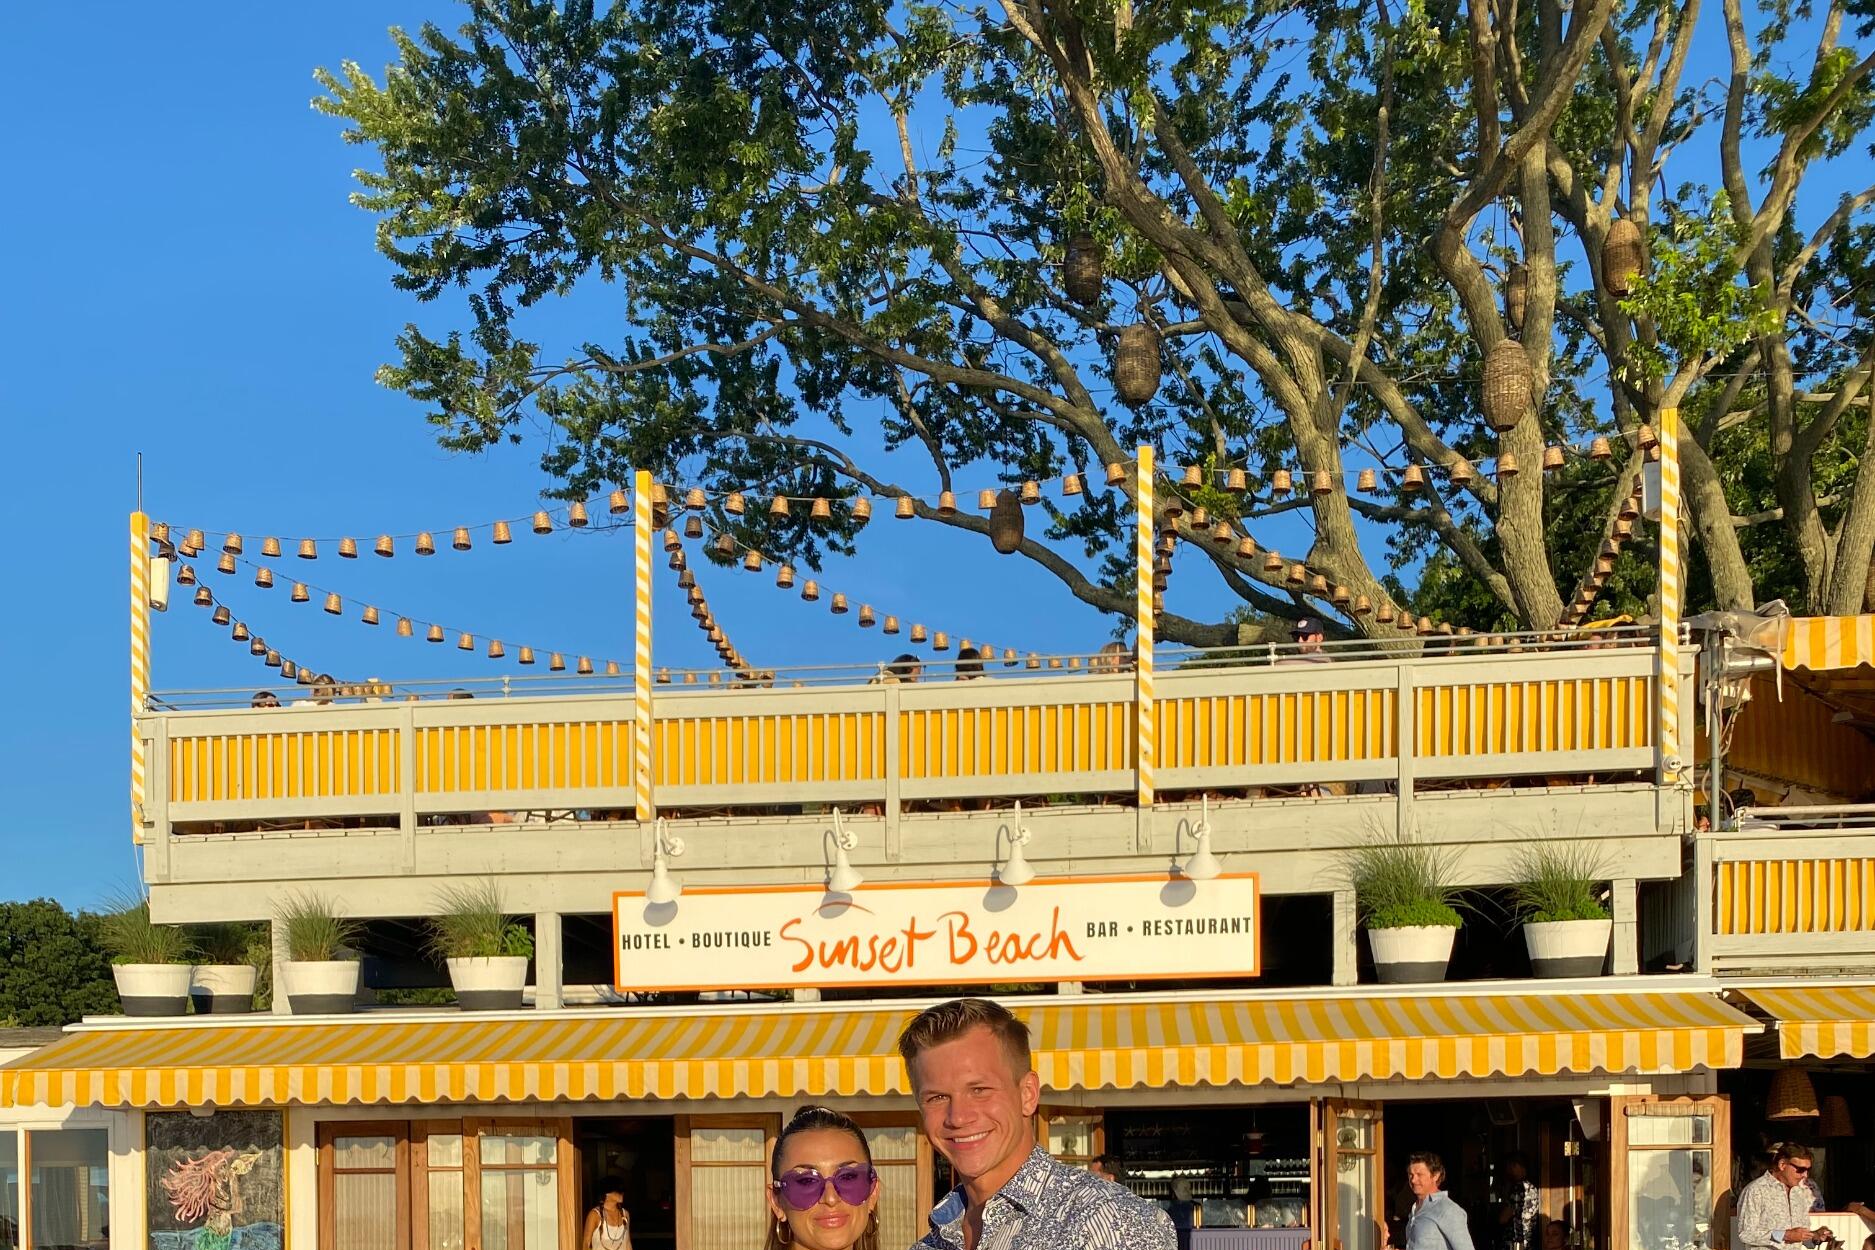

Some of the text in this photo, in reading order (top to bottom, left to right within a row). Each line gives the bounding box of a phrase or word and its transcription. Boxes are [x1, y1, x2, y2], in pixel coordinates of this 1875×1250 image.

[1086, 916, 1252, 938] BAR RESTAURANT
[621, 930, 772, 950] HOTEL BOUTIQUE
[779, 905, 1086, 974] Sunset Beach
